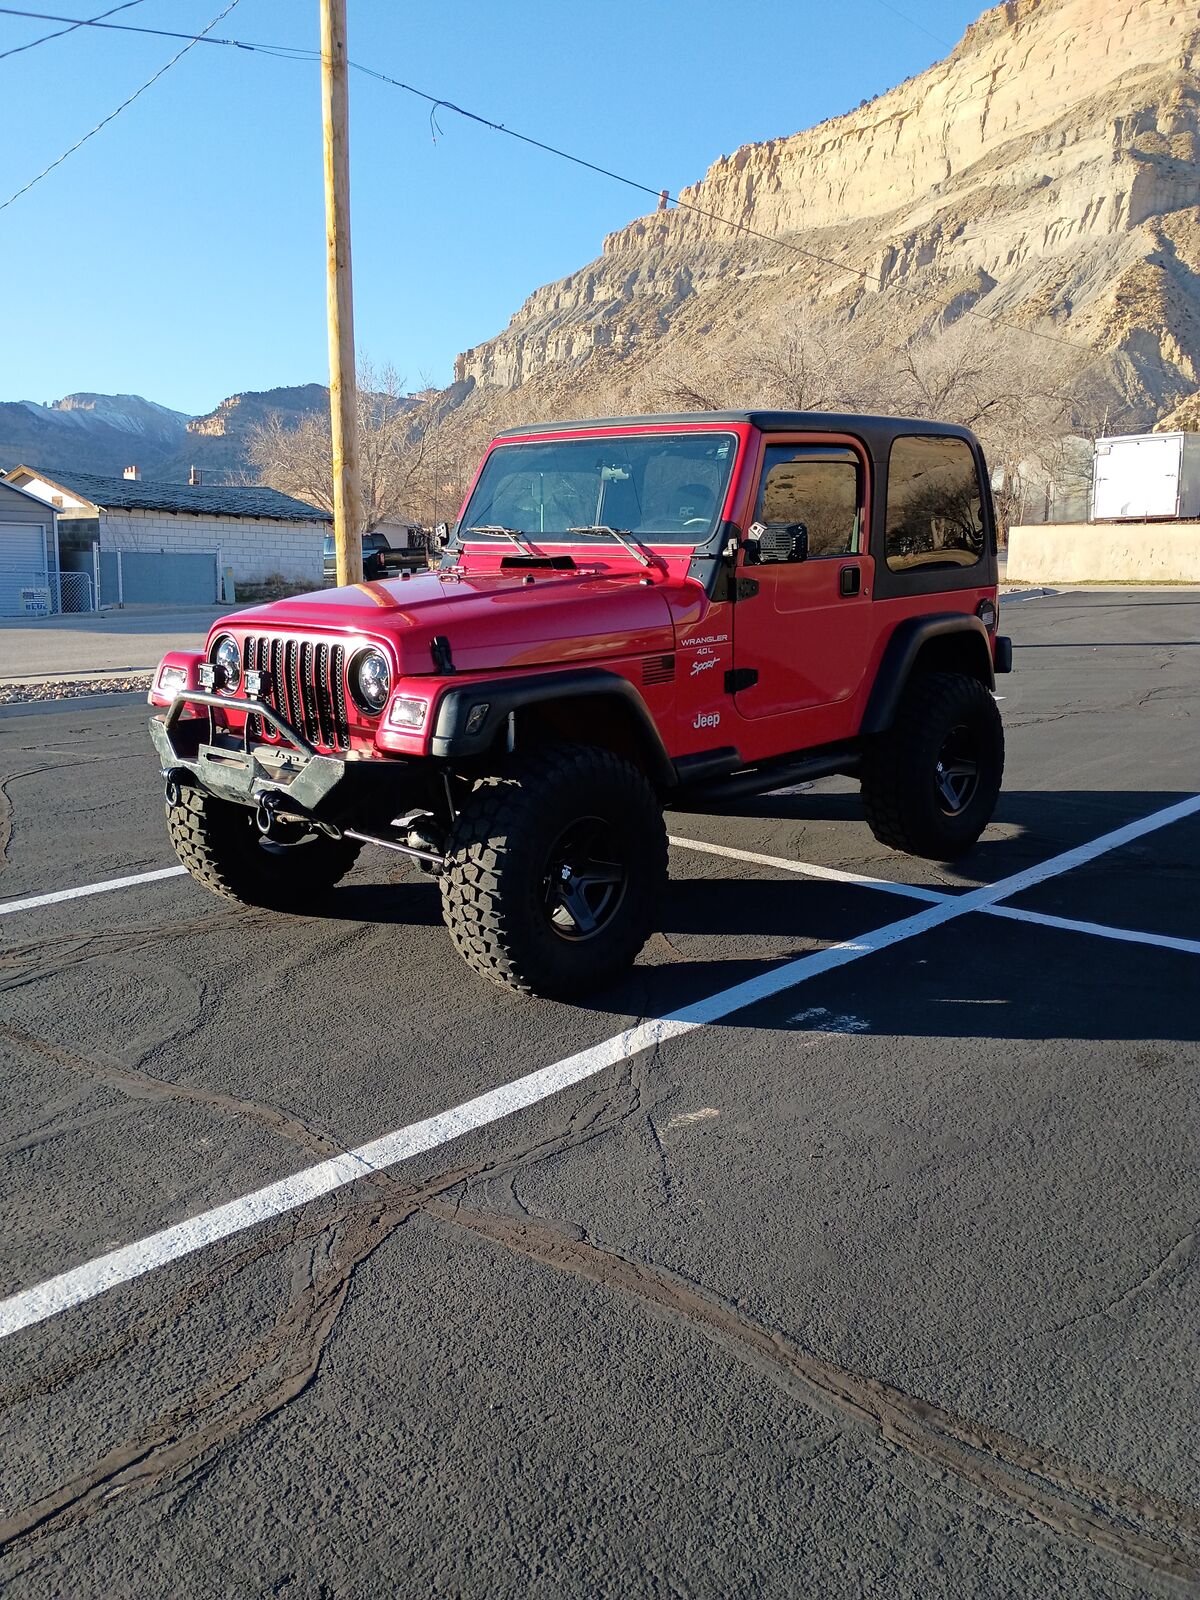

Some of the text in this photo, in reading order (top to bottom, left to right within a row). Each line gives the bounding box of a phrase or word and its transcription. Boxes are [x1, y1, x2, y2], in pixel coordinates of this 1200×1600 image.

[681, 634, 728, 646] WRANGLER
[690, 657, 721, 676] Sport
[693, 713, 720, 729] Jeep
